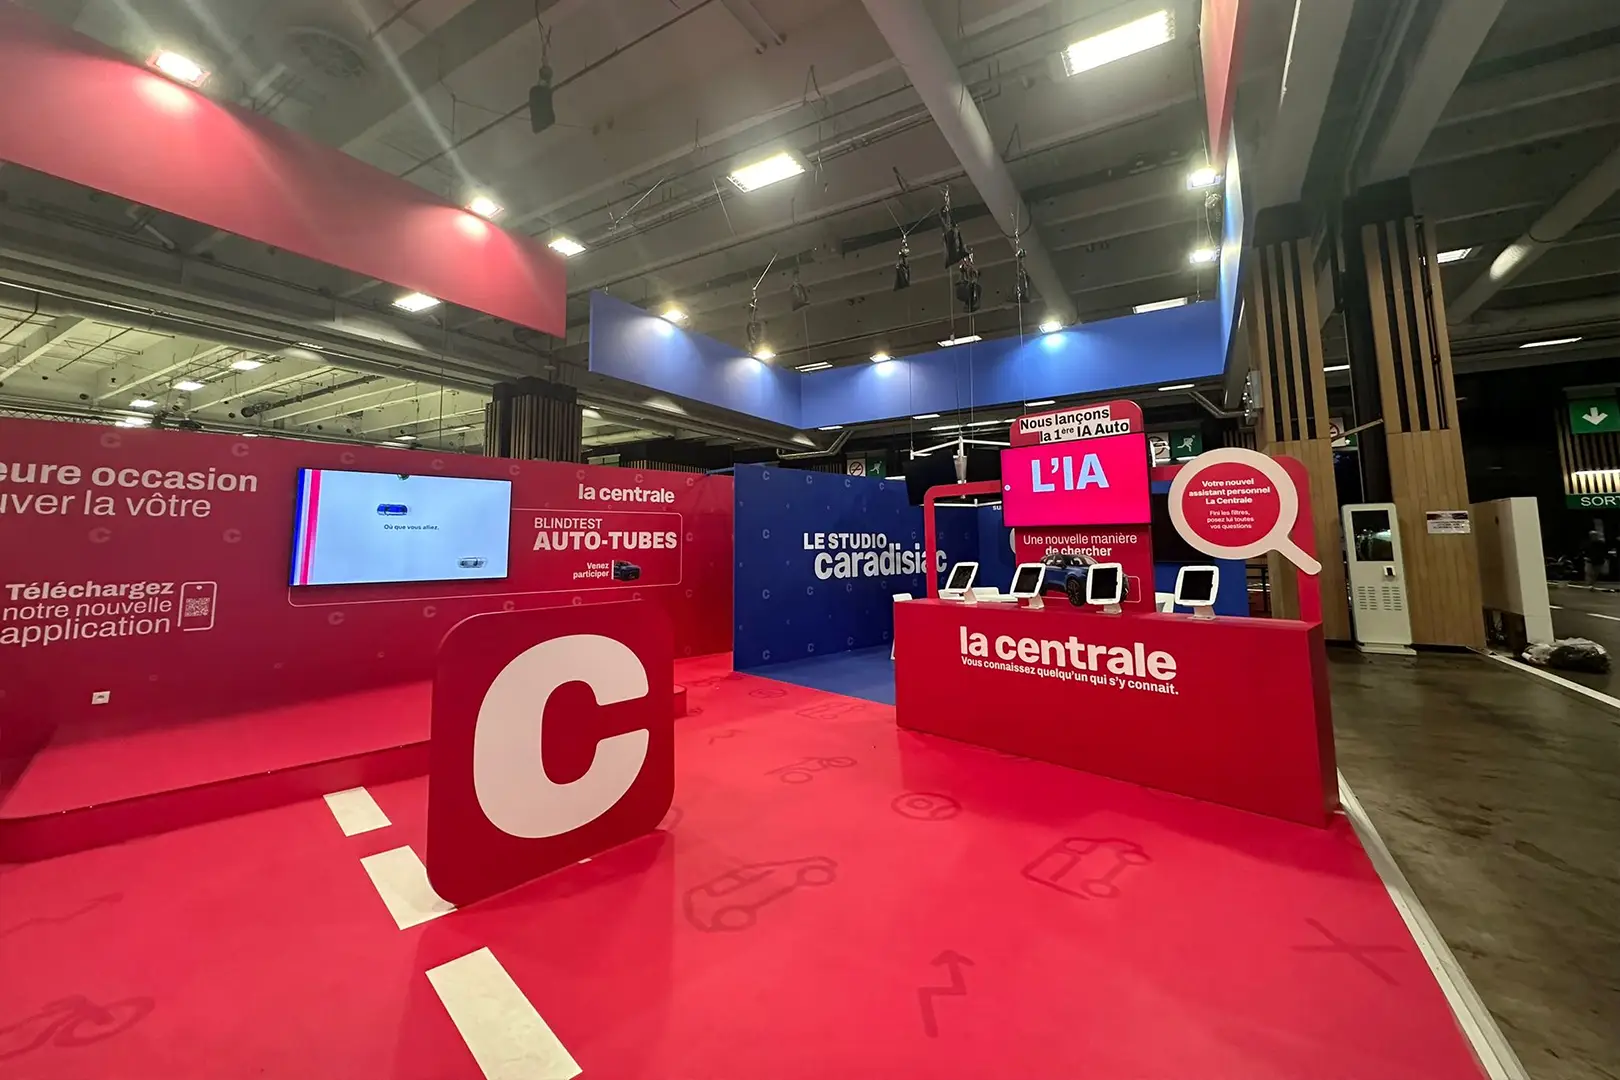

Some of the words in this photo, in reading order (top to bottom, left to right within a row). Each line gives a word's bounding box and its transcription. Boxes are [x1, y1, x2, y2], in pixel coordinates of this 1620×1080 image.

[1020, 417, 1052, 430] Nous
[1055, 408, 1110, 425] lançons
[1040, 431, 1051, 442] la
[1077, 425, 1092, 437] IA
[1094, 421, 1129, 435] Auto
[91, 466, 258, 492] occasion
[1031, 453, 1110, 493] L’IA
[1225, 478, 1254, 486] nouvel
[578, 483, 596, 500] la
[599, 486, 675, 503] centrale
[1227, 487, 1270, 496] personnel
[84, 490, 116, 516] la
[126, 492, 211, 517] vôtre
[534, 517, 603, 530] BLINDTEST
[532, 531, 678, 551] AUTO-TUBES
[803, 532, 825, 550] LE
[828, 532, 887, 549] STUDIO
[1023, 534, 1044, 545] Une
[1045, 533, 1089, 545] nouvelle
[1090, 532, 1137, 544] manière
[1045, 545, 1059, 555] de
[1060, 544, 1112, 556] chercher
[573, 569, 609, 580] participer
[586, 562, 609, 570] Venez
[5, 580, 175, 601] Téléchargez
[2, 602, 69, 621] notre
[76, 597, 173, 617] nouvelle
[0, 615, 171, 648] application
[959, 625, 988, 658] la
[994, 634, 1177, 681] centrale
[961, 656, 983, 668] Vous
[983, 660, 1036, 675] connaissez
[1037, 667, 1088, 682] quelqu’un
[1089, 673, 1108, 686] qui
[1109, 676, 1126, 689] s’y
